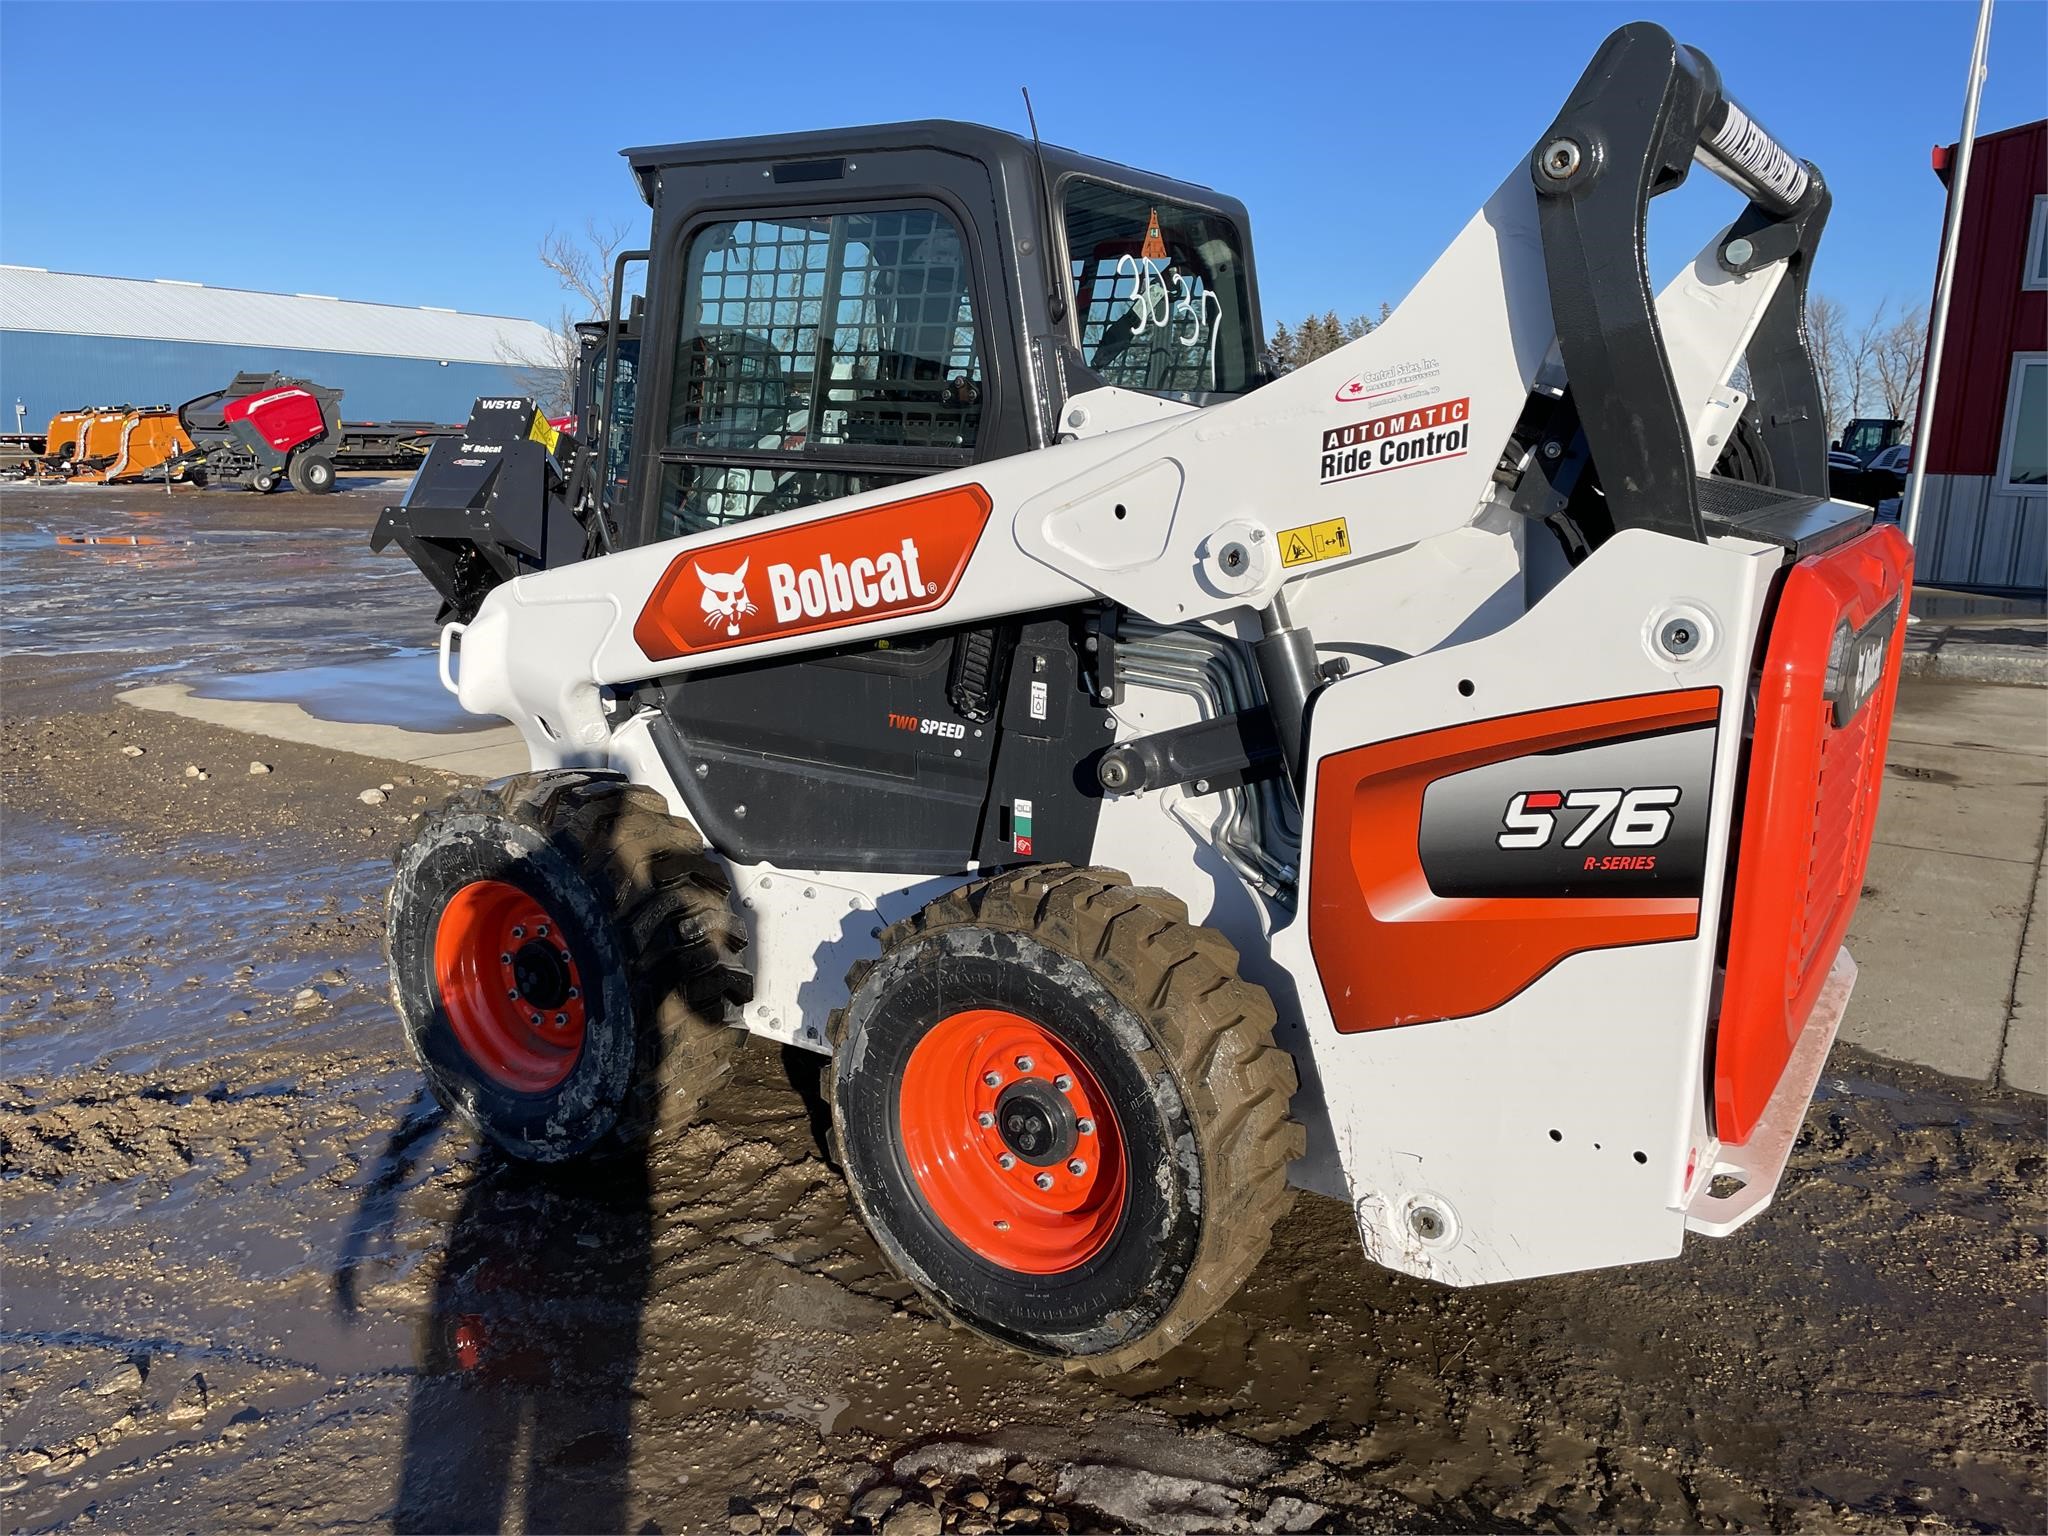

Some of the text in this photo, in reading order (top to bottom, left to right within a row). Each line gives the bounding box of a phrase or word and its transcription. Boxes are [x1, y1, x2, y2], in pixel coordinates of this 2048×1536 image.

[1364, 358, 1440, 384] Central Sales, Inc.
[482, 400, 521, 410] WS18
[1327, 402, 1464, 449] AUTOMATIC
[473, 443, 503, 454] Bobcat
[1321, 423, 1469, 479] Ride Control
[766, 537, 927, 624] Bobcat
[888, 713, 965, 740] TWO SPEED
[1497, 787, 1681, 849] S76
[1583, 856, 1656, 870] R-SERIES
